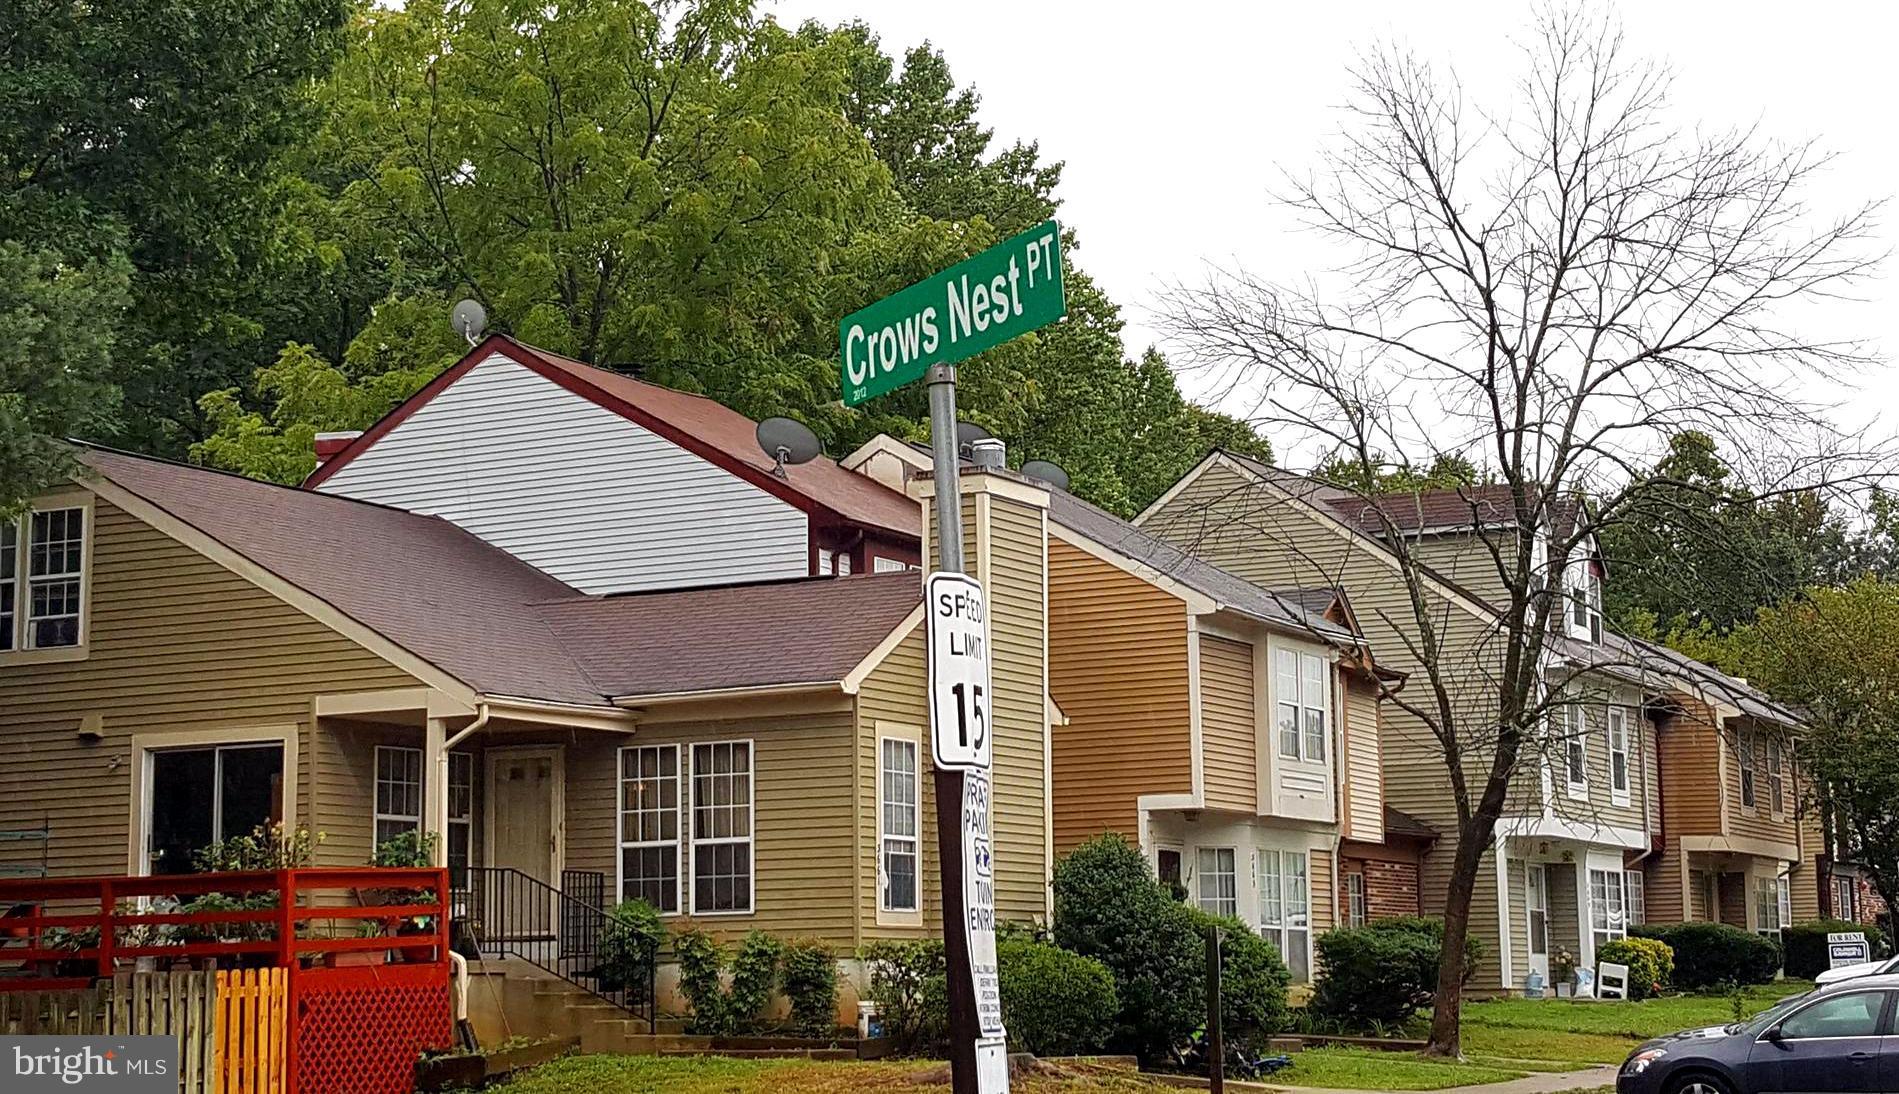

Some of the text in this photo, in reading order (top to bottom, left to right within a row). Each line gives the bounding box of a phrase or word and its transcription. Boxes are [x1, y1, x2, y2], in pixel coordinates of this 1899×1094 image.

[846, 233, 1054, 386] Crows Nest PT
[853, 387, 867, 401] 2012
[939, 591, 982, 623] SPEED
[950, 632, 982, 660] LIMIT
[952, 683, 984, 750] 15
